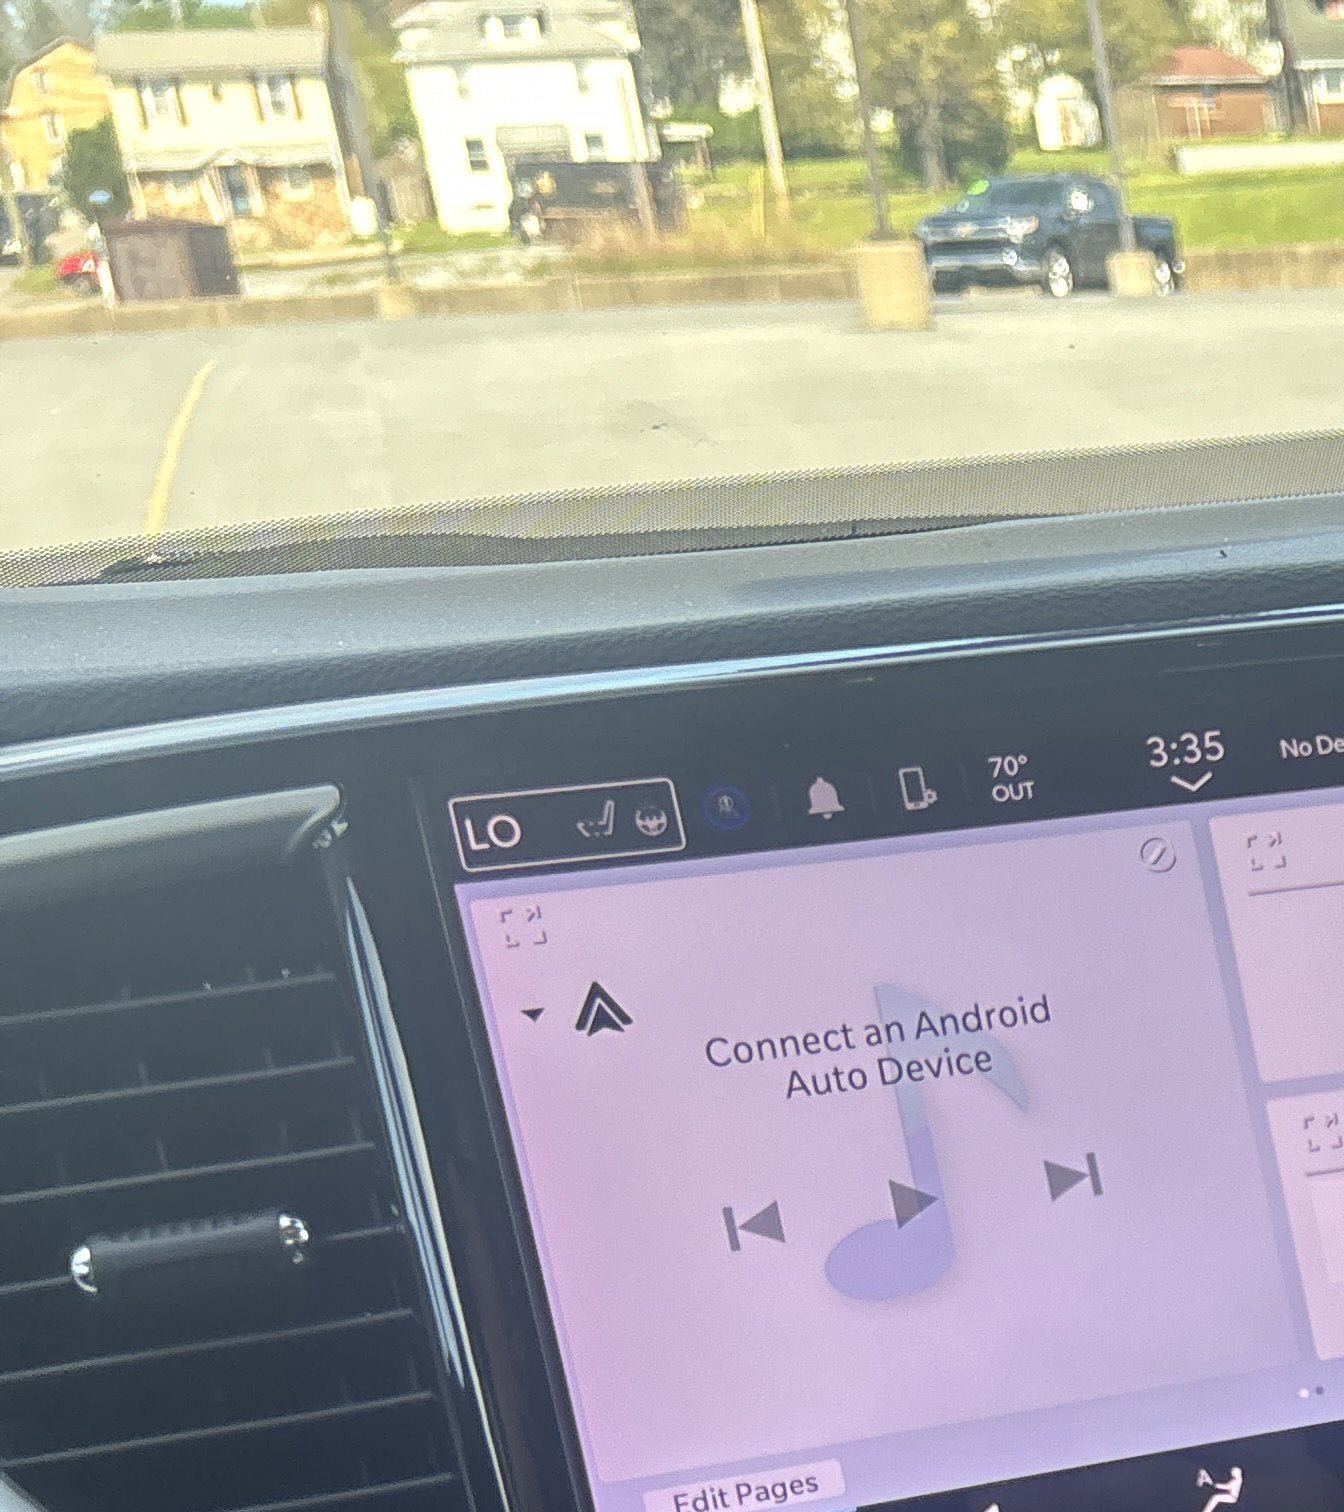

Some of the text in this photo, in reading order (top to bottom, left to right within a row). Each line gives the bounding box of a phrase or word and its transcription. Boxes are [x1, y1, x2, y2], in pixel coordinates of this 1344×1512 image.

[1147, 731, 1226, 769] 3:35
[1280, 735, 1312, 759] No
[988, 755, 1028, 779] 70°
[992, 781, 1036, 804] OUT
[466, 813, 522, 852] LO
[705, 994, 1052, 1070] Connect an Android
[784, 1046, 994, 1100] Auto Device
[736, 1471, 820, 1510] Pages
